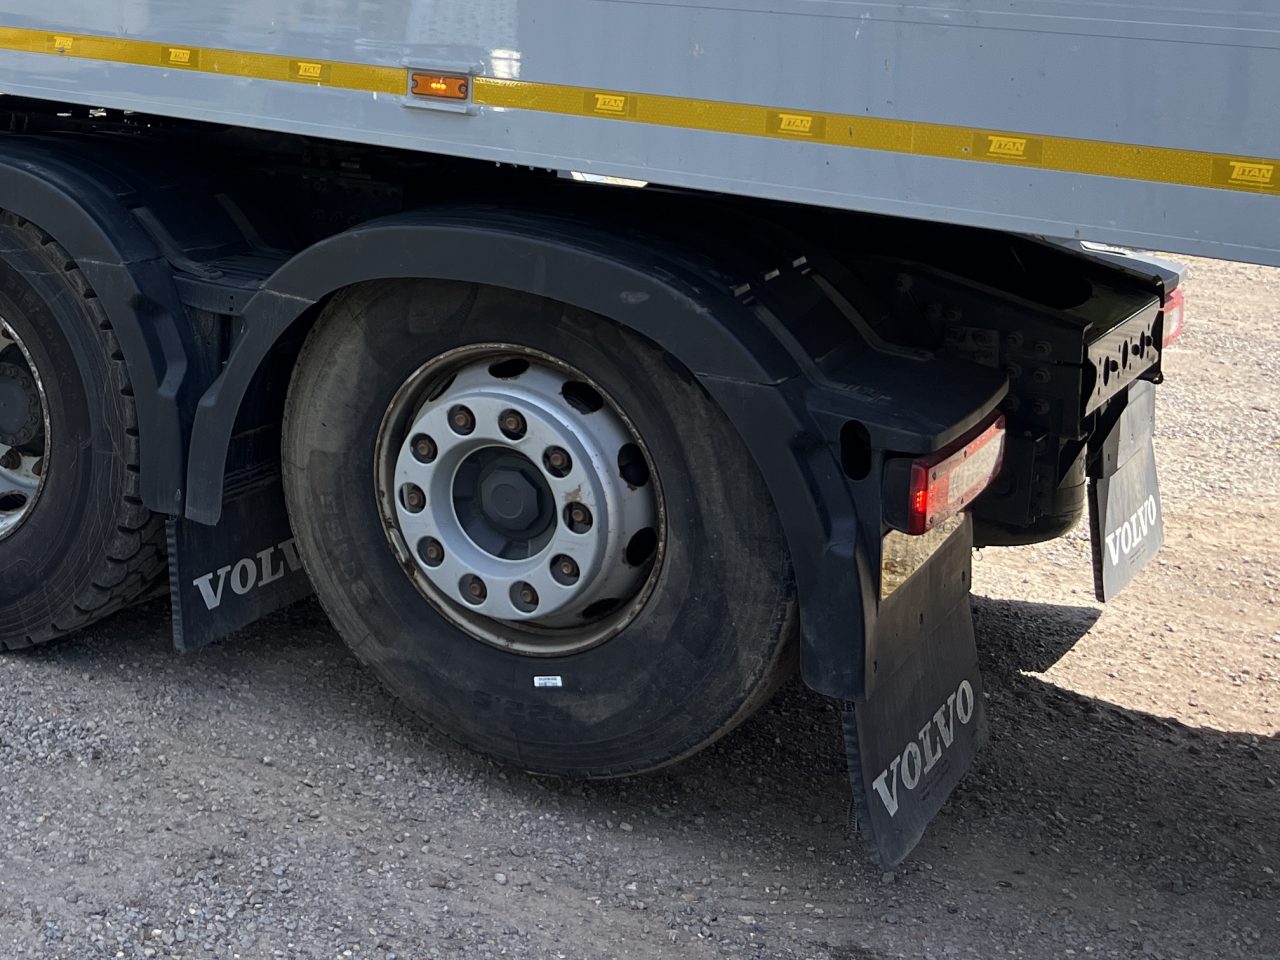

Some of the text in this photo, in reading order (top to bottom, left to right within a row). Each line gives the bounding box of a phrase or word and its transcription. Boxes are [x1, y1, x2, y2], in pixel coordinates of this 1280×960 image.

[595, 94, 625, 111] TITAN
[779, 113, 812, 132] TITAN
[988, 135, 1026, 155] TITAN
[1230, 161, 1274, 183] TITAN
[1106, 494, 1157, 566] VOLVO
[872, 679, 974, 818] VOLVO
